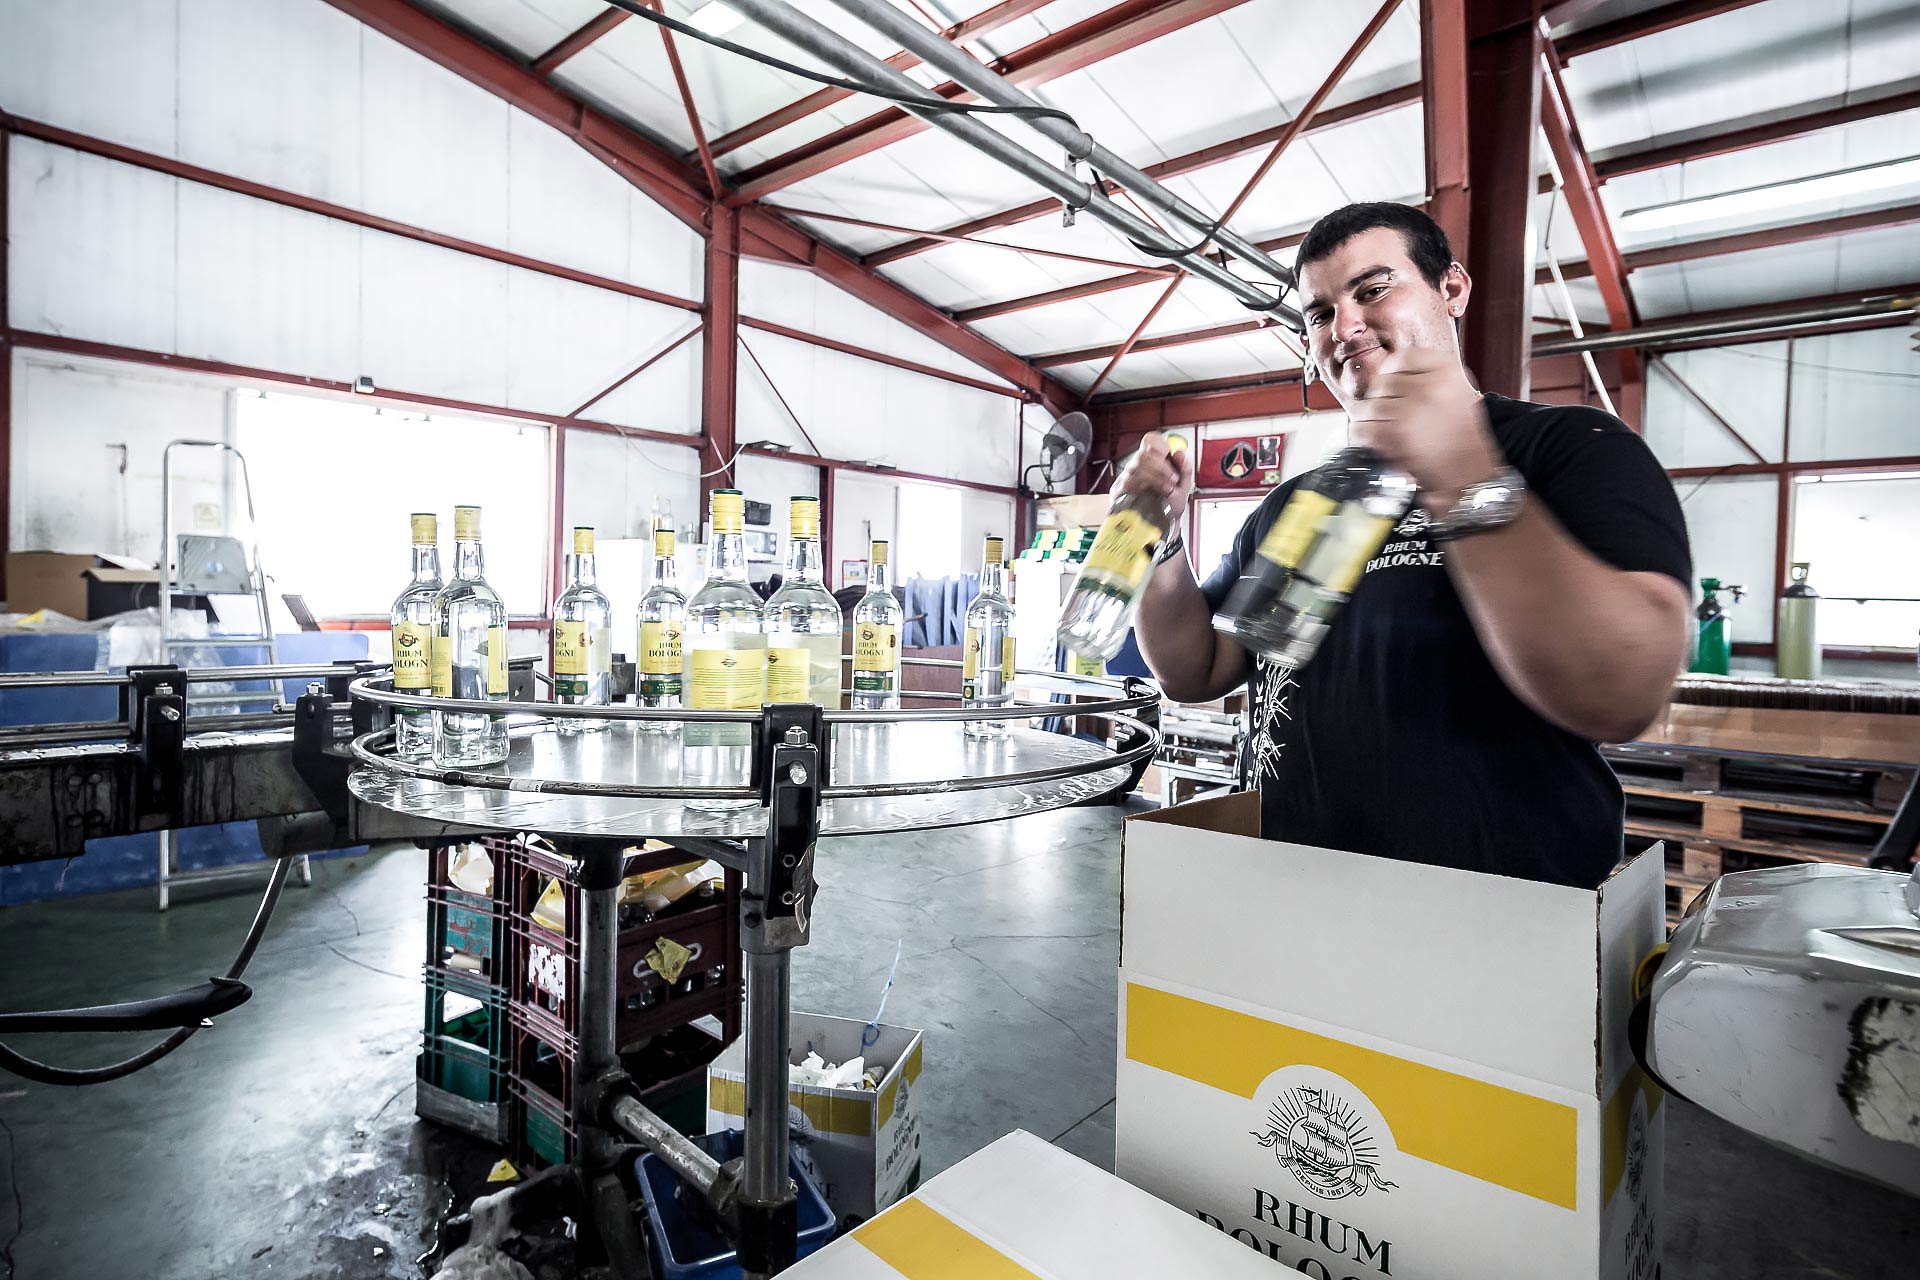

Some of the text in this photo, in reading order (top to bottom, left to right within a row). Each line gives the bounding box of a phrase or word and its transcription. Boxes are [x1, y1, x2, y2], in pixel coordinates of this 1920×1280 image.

[1383, 540, 1427, 554] RHUM
[1365, 552, 1445, 574] BOLOGNE
[648, 649, 682, 657] BOLOG
[1295, 1169, 1324, 1194] DEPUIS
[1252, 1187, 1393, 1276] RHUM
